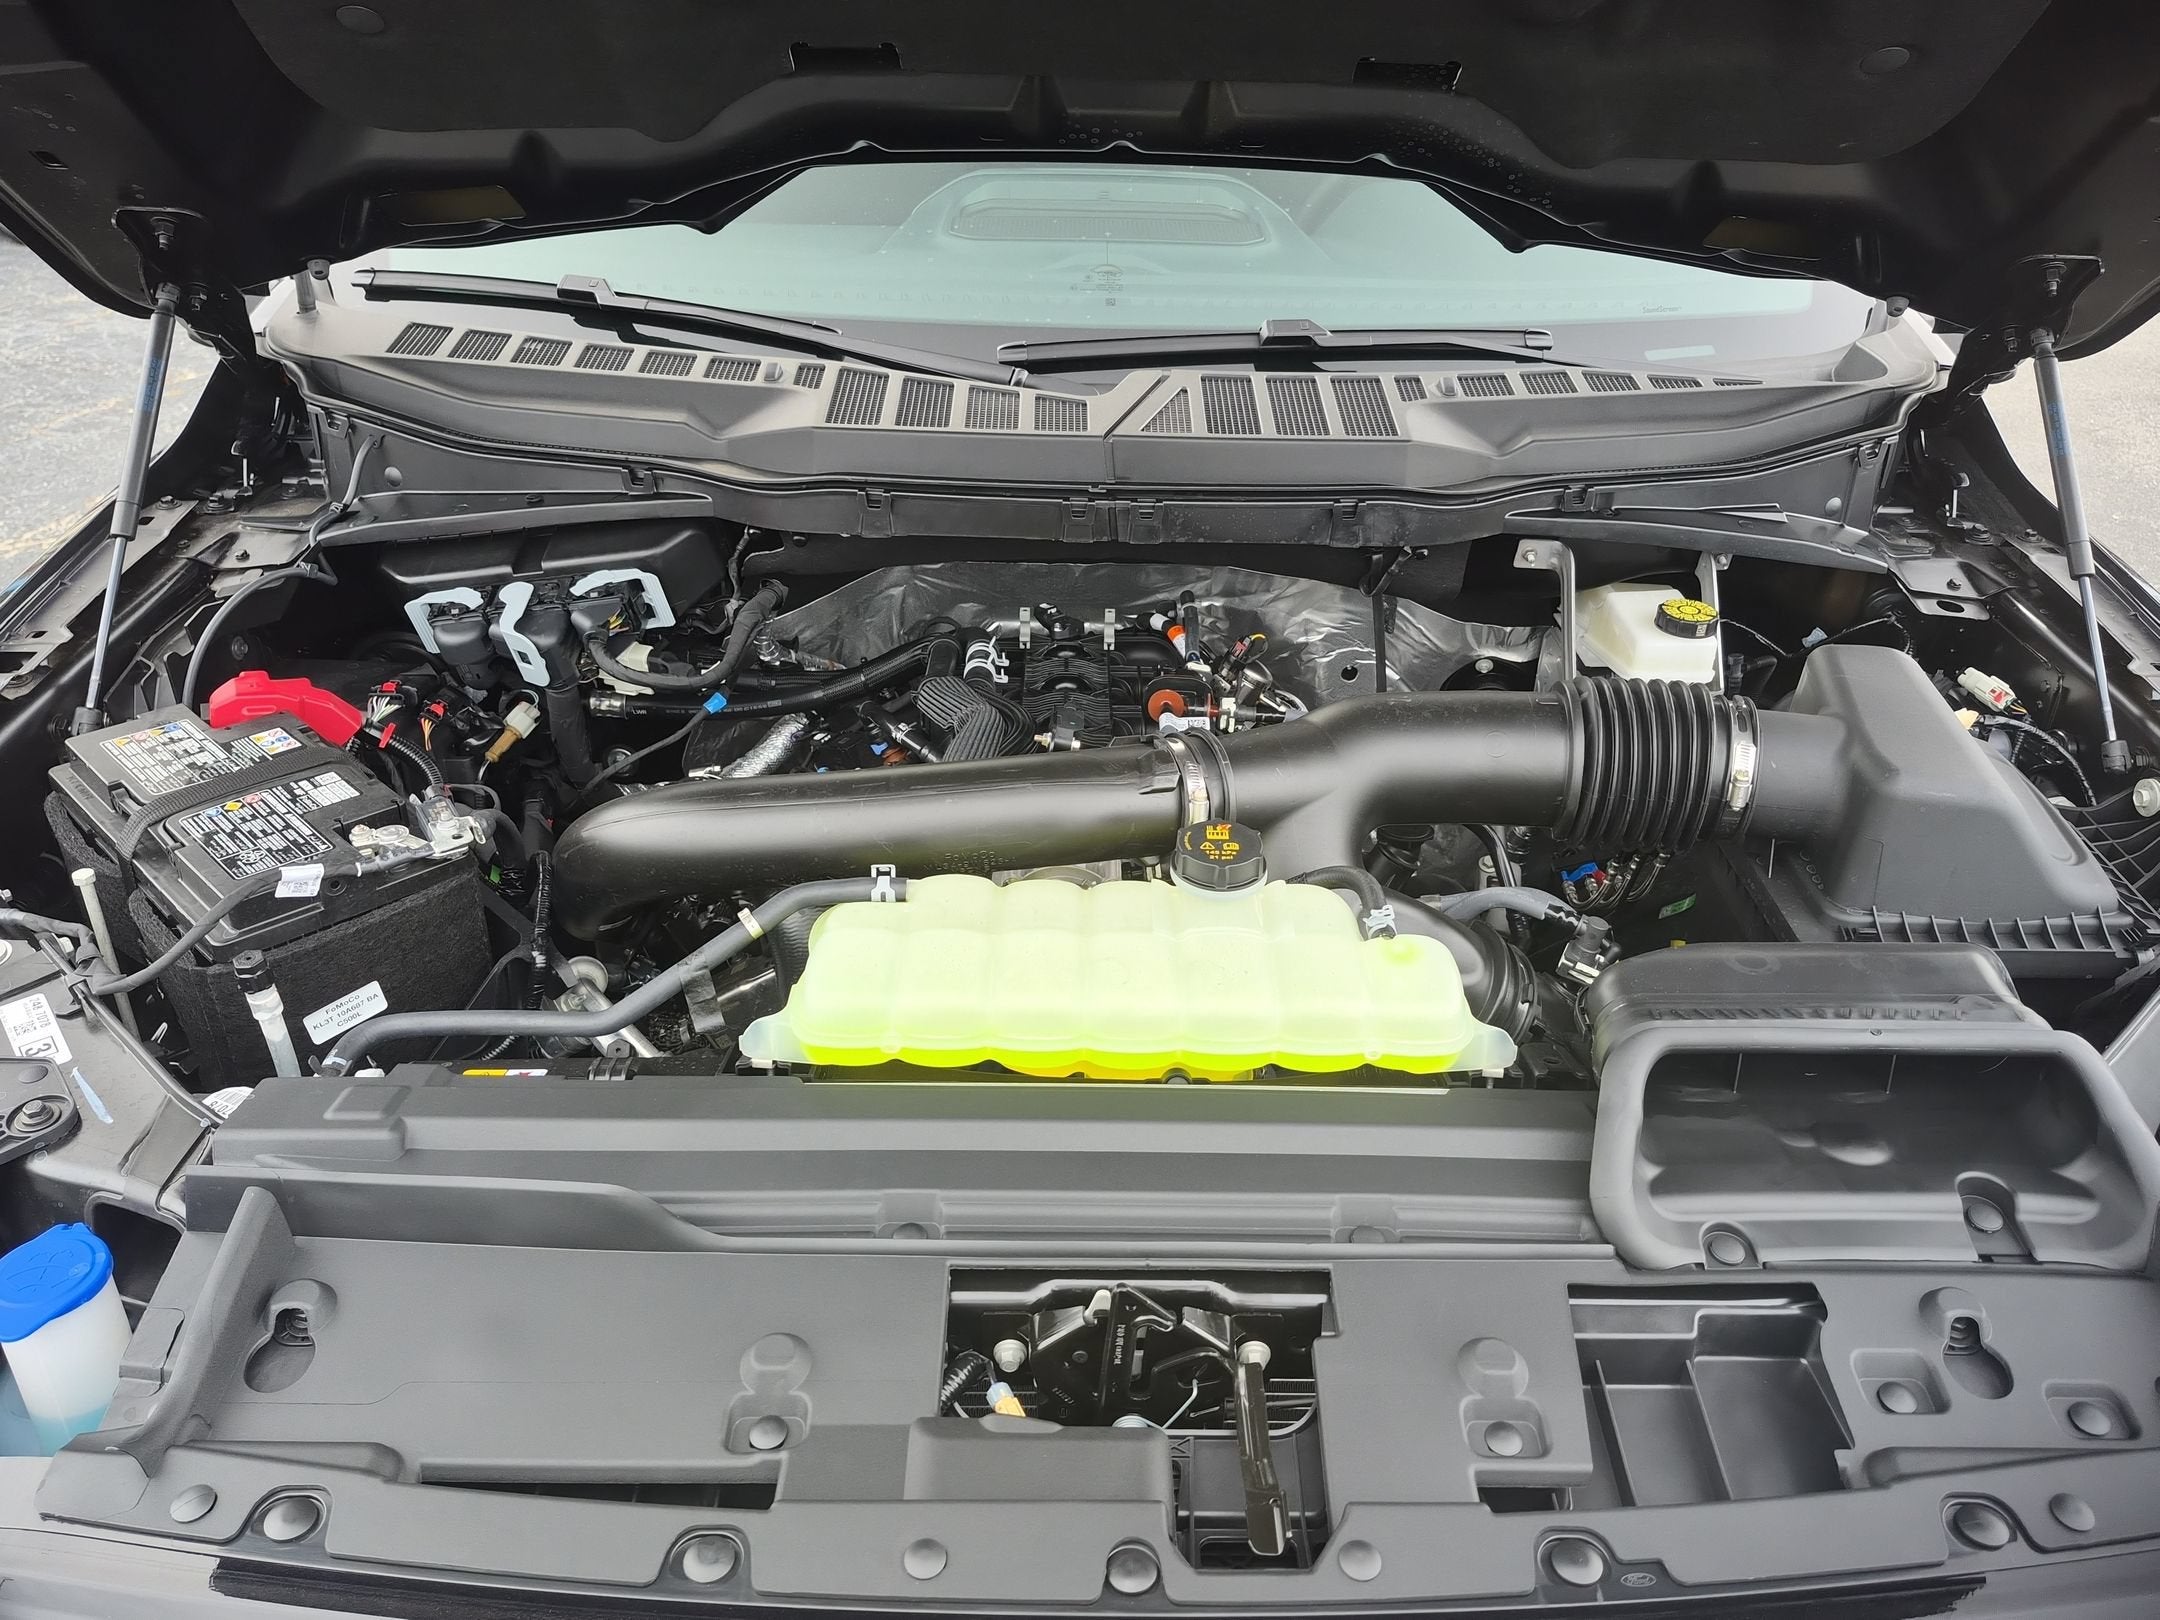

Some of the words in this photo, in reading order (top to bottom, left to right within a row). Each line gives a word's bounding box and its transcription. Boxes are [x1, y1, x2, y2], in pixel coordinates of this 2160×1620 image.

[312, 1015, 335, 1031] KL3T
[366, 993, 379, 1003] BA
[325, 994, 360, 1015] FoMoCo
[336, 1011, 362, 1027] C500L
[24, 1042, 52, 1057] 3
